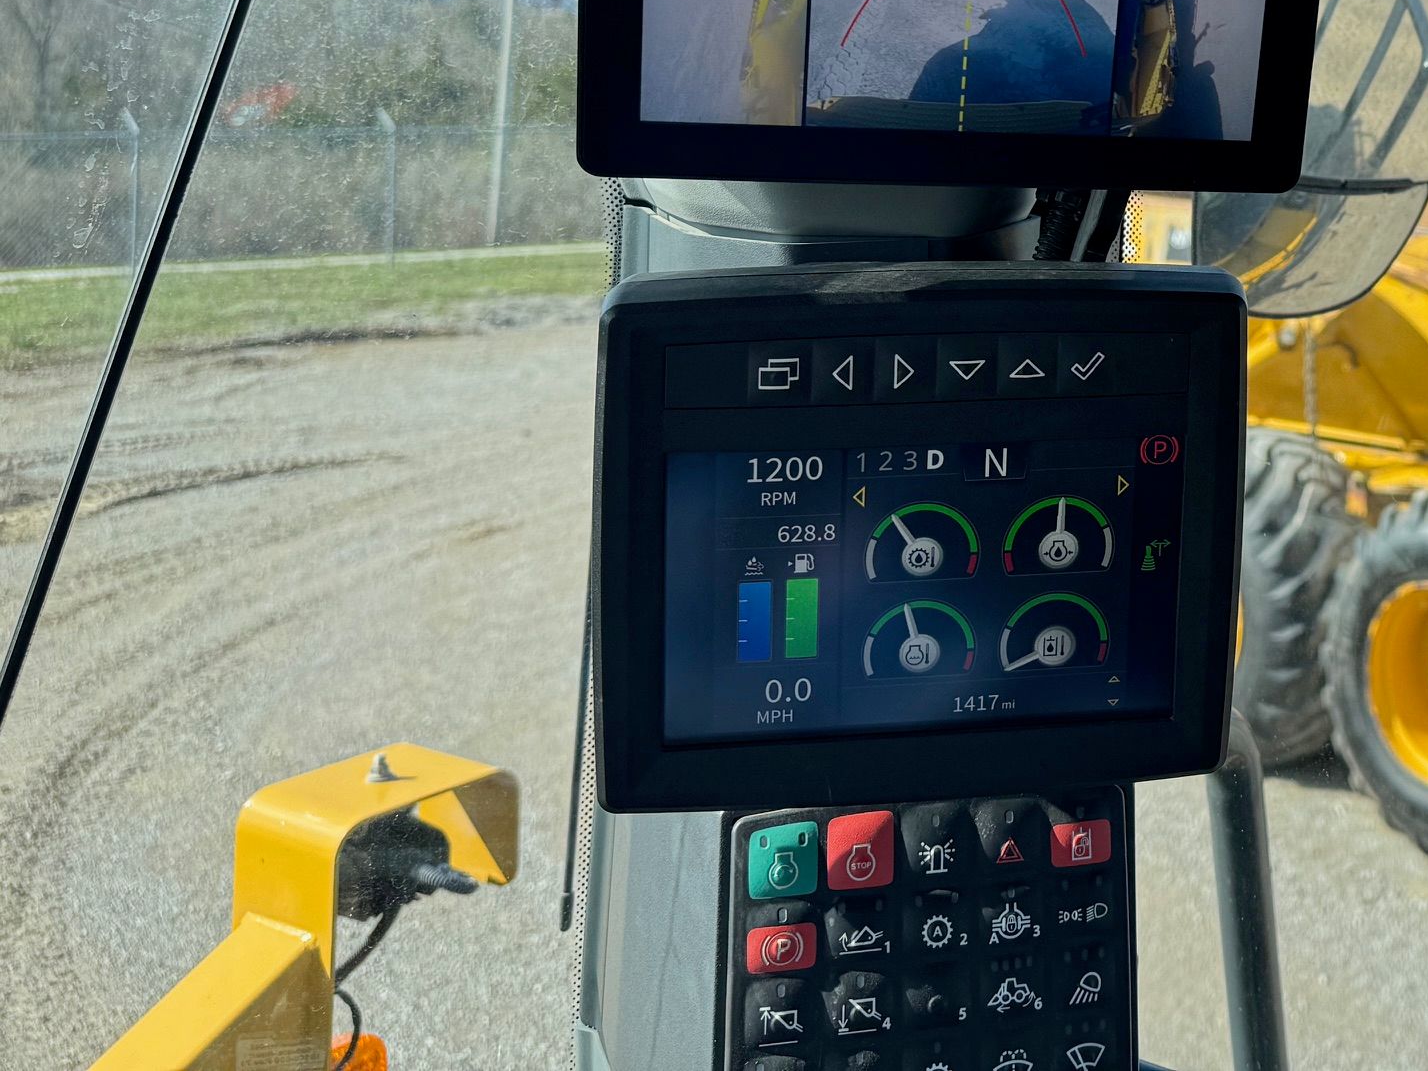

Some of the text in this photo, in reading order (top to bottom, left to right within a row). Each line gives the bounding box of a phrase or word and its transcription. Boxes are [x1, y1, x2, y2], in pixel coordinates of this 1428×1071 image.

[745, 455, 824, 485] 1200
[856, 450, 945, 473] 1 2 3 D
[984, 448, 1008, 478] N
[760, 491, 797, 508] RPM
[777, 523, 836, 545] 628.8
[764, 678, 812, 704] 0.0
[952, 694, 999, 713] 1417
[756, 708, 794, 725] MPH
[850, 861, 872, 872] STOP
[960, 933, 968, 946] 2
[989, 932, 999, 945] A
[1032, 924, 1041, 938] 3
[775, 937, 792, 961] P
[884, 940, 891, 953] 1
[1034, 997, 1043, 1012] 6
[959, 1006, 967, 1021] 5
[882, 1016, 892, 1031] 4
